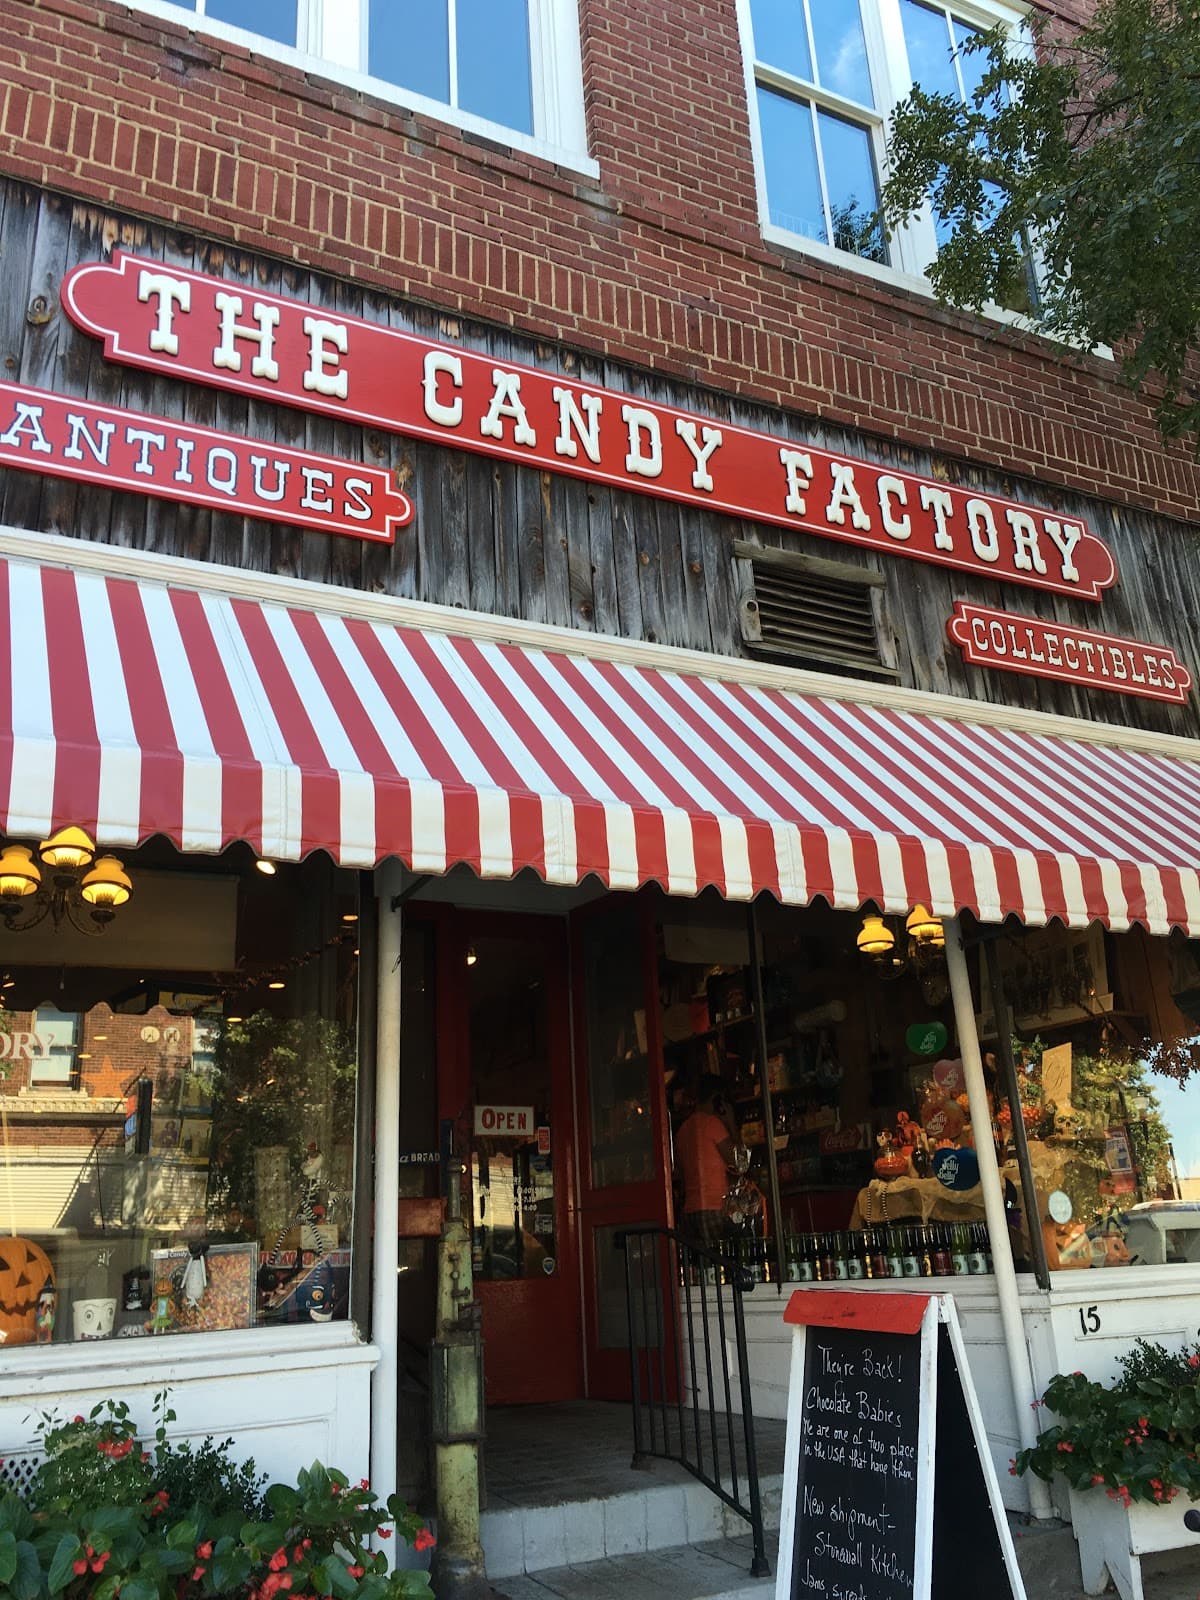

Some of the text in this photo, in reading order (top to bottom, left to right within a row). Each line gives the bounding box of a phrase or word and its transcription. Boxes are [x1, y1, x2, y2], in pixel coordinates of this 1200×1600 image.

[137, 270, 1082, 583] THE CANDY FACTORY
[0, 402, 374, 521] ANTIQUES
[970, 617, 1177, 690] COLLECTIBLES
[481, 1108, 527, 1130] OPEN
[937, 1167, 957, 1183] Belly
[941, 1156, 960, 1173] Jelly
[1079, 1305, 1101, 1336] 15
[817, 1344, 902, 1383] They're Back!
[805, 1380, 902, 1427] Chocolate Babies
[803, 1417, 814, 1436] We
[816, 1424, 831, 1438] are
[833, 1429, 849, 1443] one
[852, 1427, 864, 1445] of
[867, 1430, 885, 1454] two
[804, 1439, 812, 1456] in
[813, 1441, 827, 1461] the
[827, 1444, 846, 1466] USA
[848, 1449, 868, 1469] that
[870, 1453, 889, 1474] have
[803, 1484, 825, 1517] New
[870, 1543, 914, 1588] Kitchen
